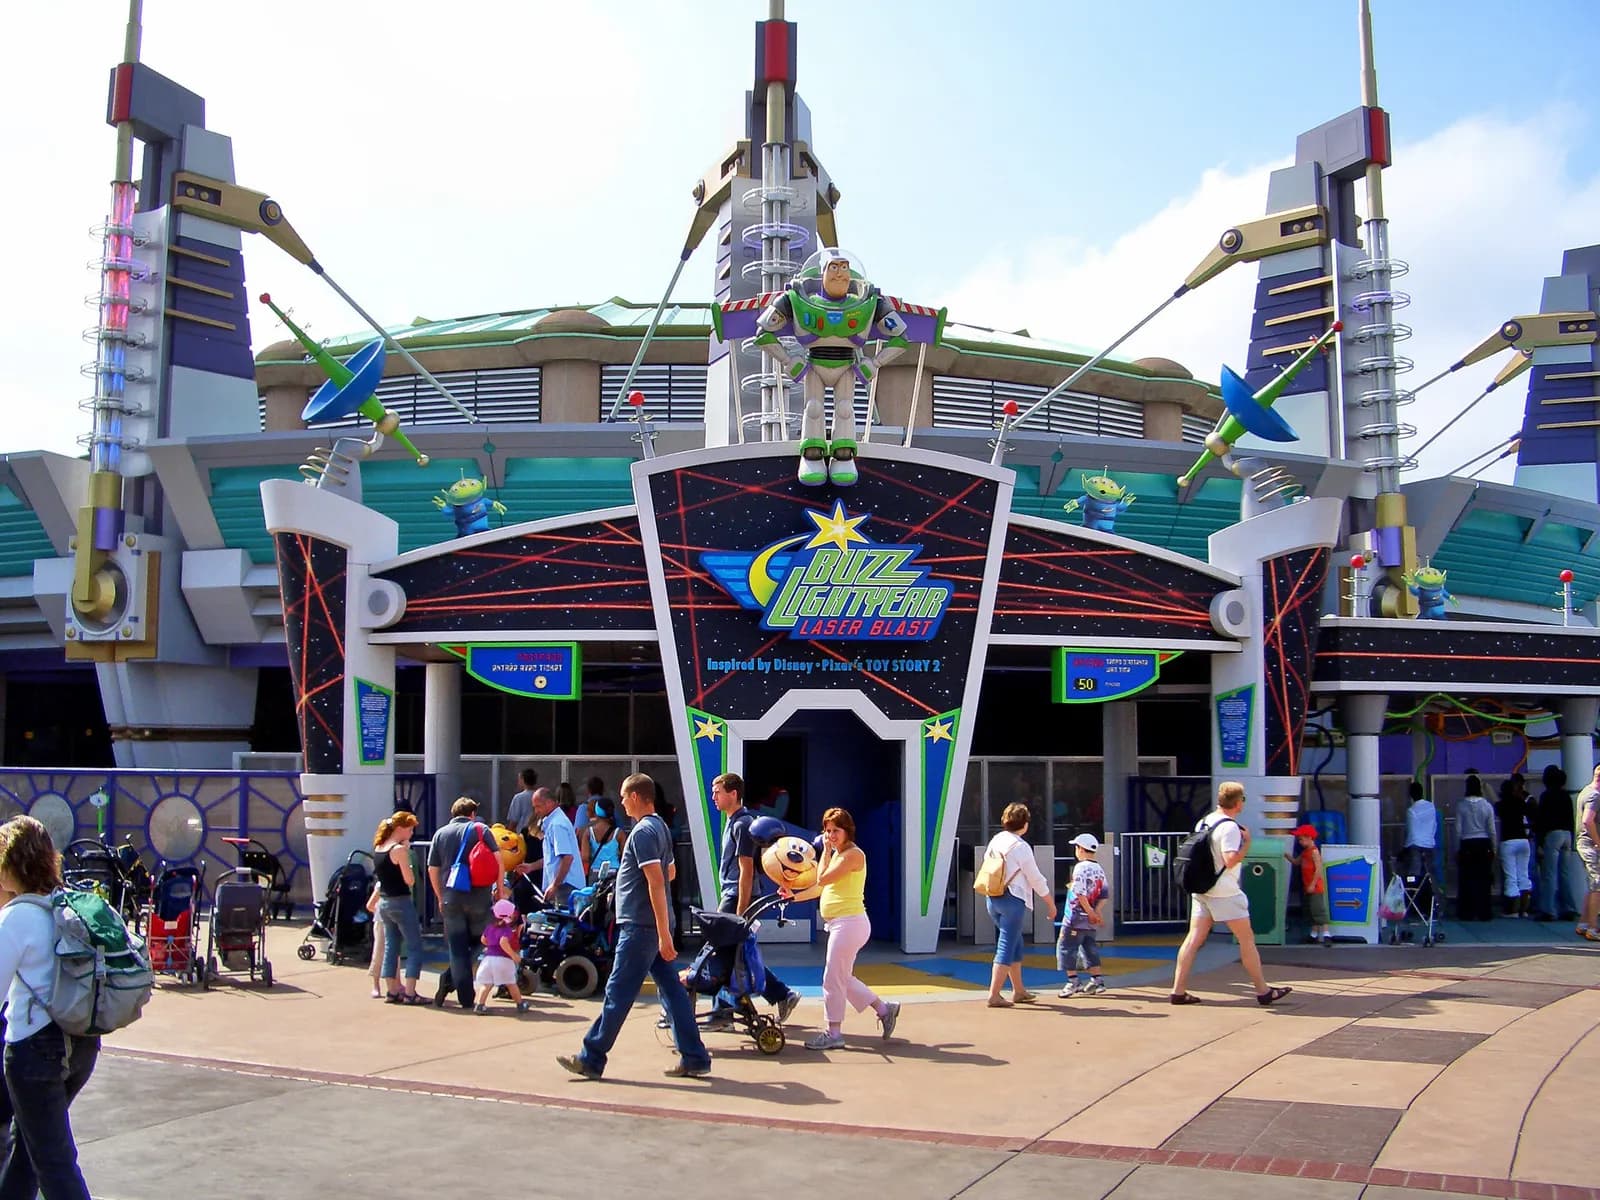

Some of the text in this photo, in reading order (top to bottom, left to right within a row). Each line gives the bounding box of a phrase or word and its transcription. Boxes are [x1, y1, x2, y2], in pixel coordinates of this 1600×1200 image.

[802, 549, 923, 586] BUZZ
[767, 567, 948, 627] LIGHTYEAR
[800, 619, 934, 636] LASER BLAST
[707, 657, 755, 674] Inspired
[757, 657, 772, 674] by
[866, 659, 890, 672] TOY
[892, 659, 931, 672] STORY
[932, 659, 941, 672] 2
[1078, 678, 1094, 690] 50
